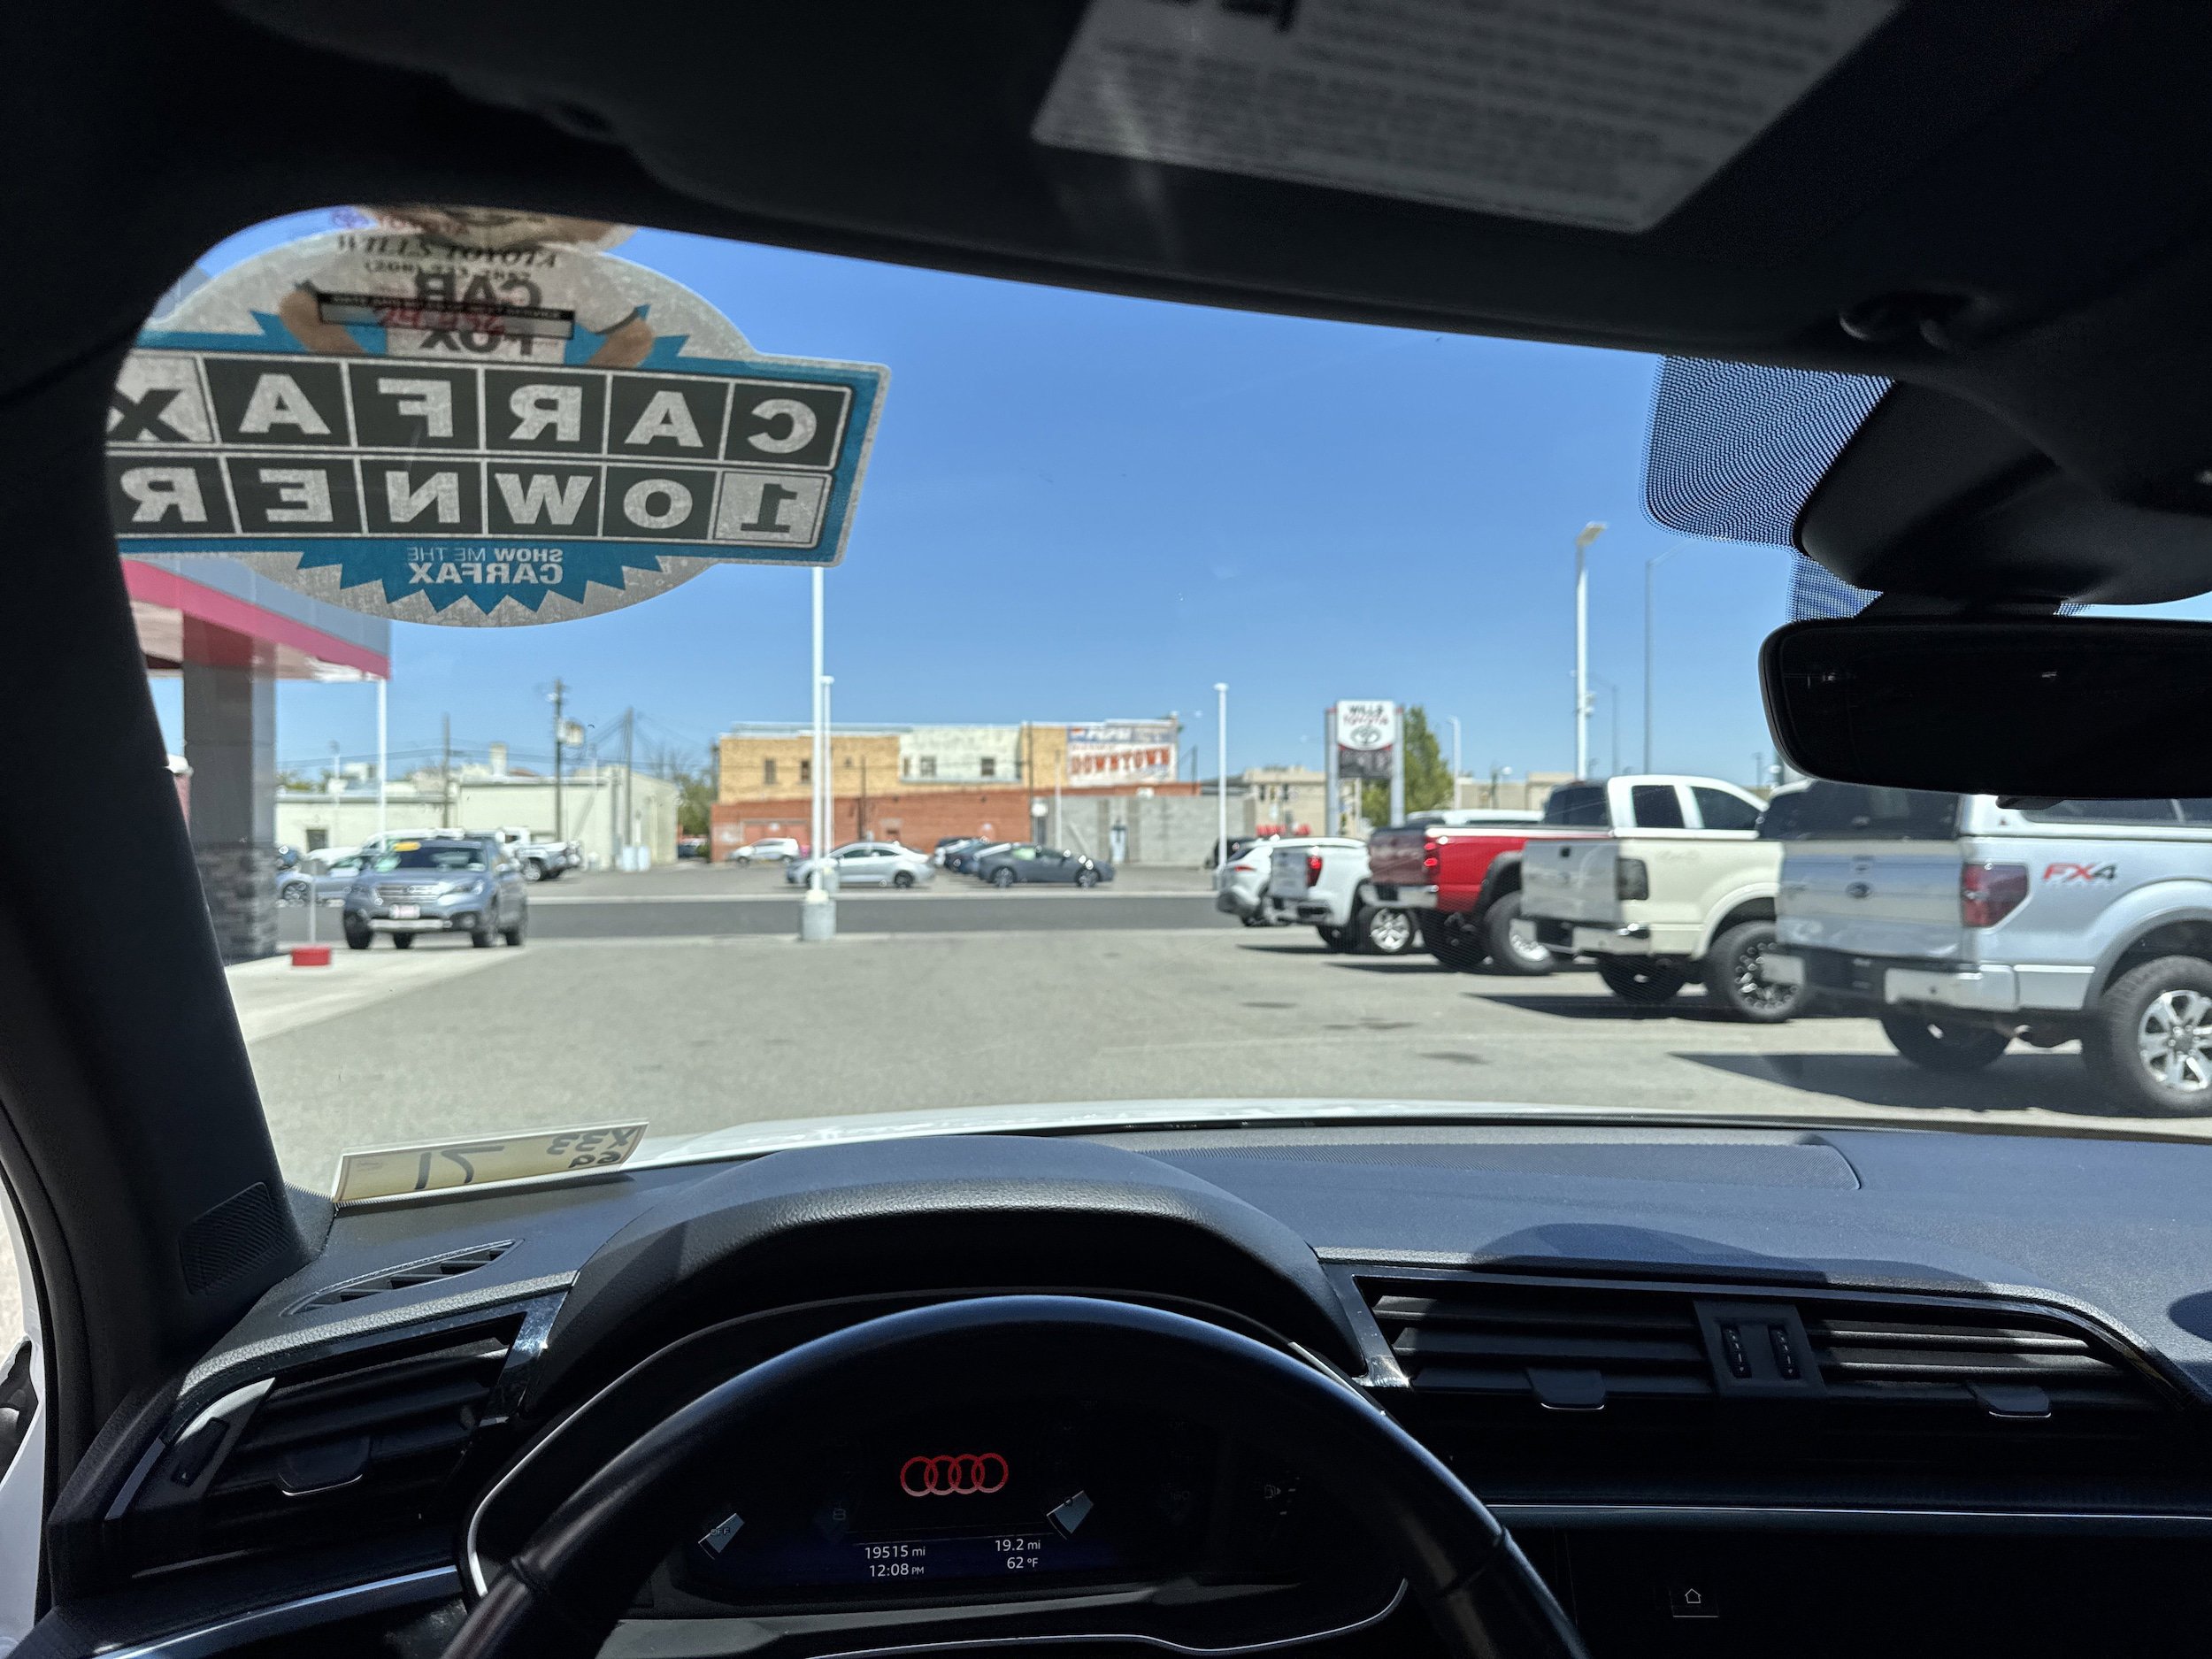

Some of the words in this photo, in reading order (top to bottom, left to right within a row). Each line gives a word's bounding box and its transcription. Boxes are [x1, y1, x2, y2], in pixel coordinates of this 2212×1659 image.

[2042, 862, 2116, 882] FX4
[864, 1545, 909, 1560] 19515
[911, 1546, 926, 1557] mi
[995, 1539, 1025, 1552] 19.2
[1027, 1540, 1041, 1550] mi
[869, 1563, 910, 1578] 12:08
[911, 1566, 926, 1575] PM
[1006, 1556, 1025, 1570] 62
